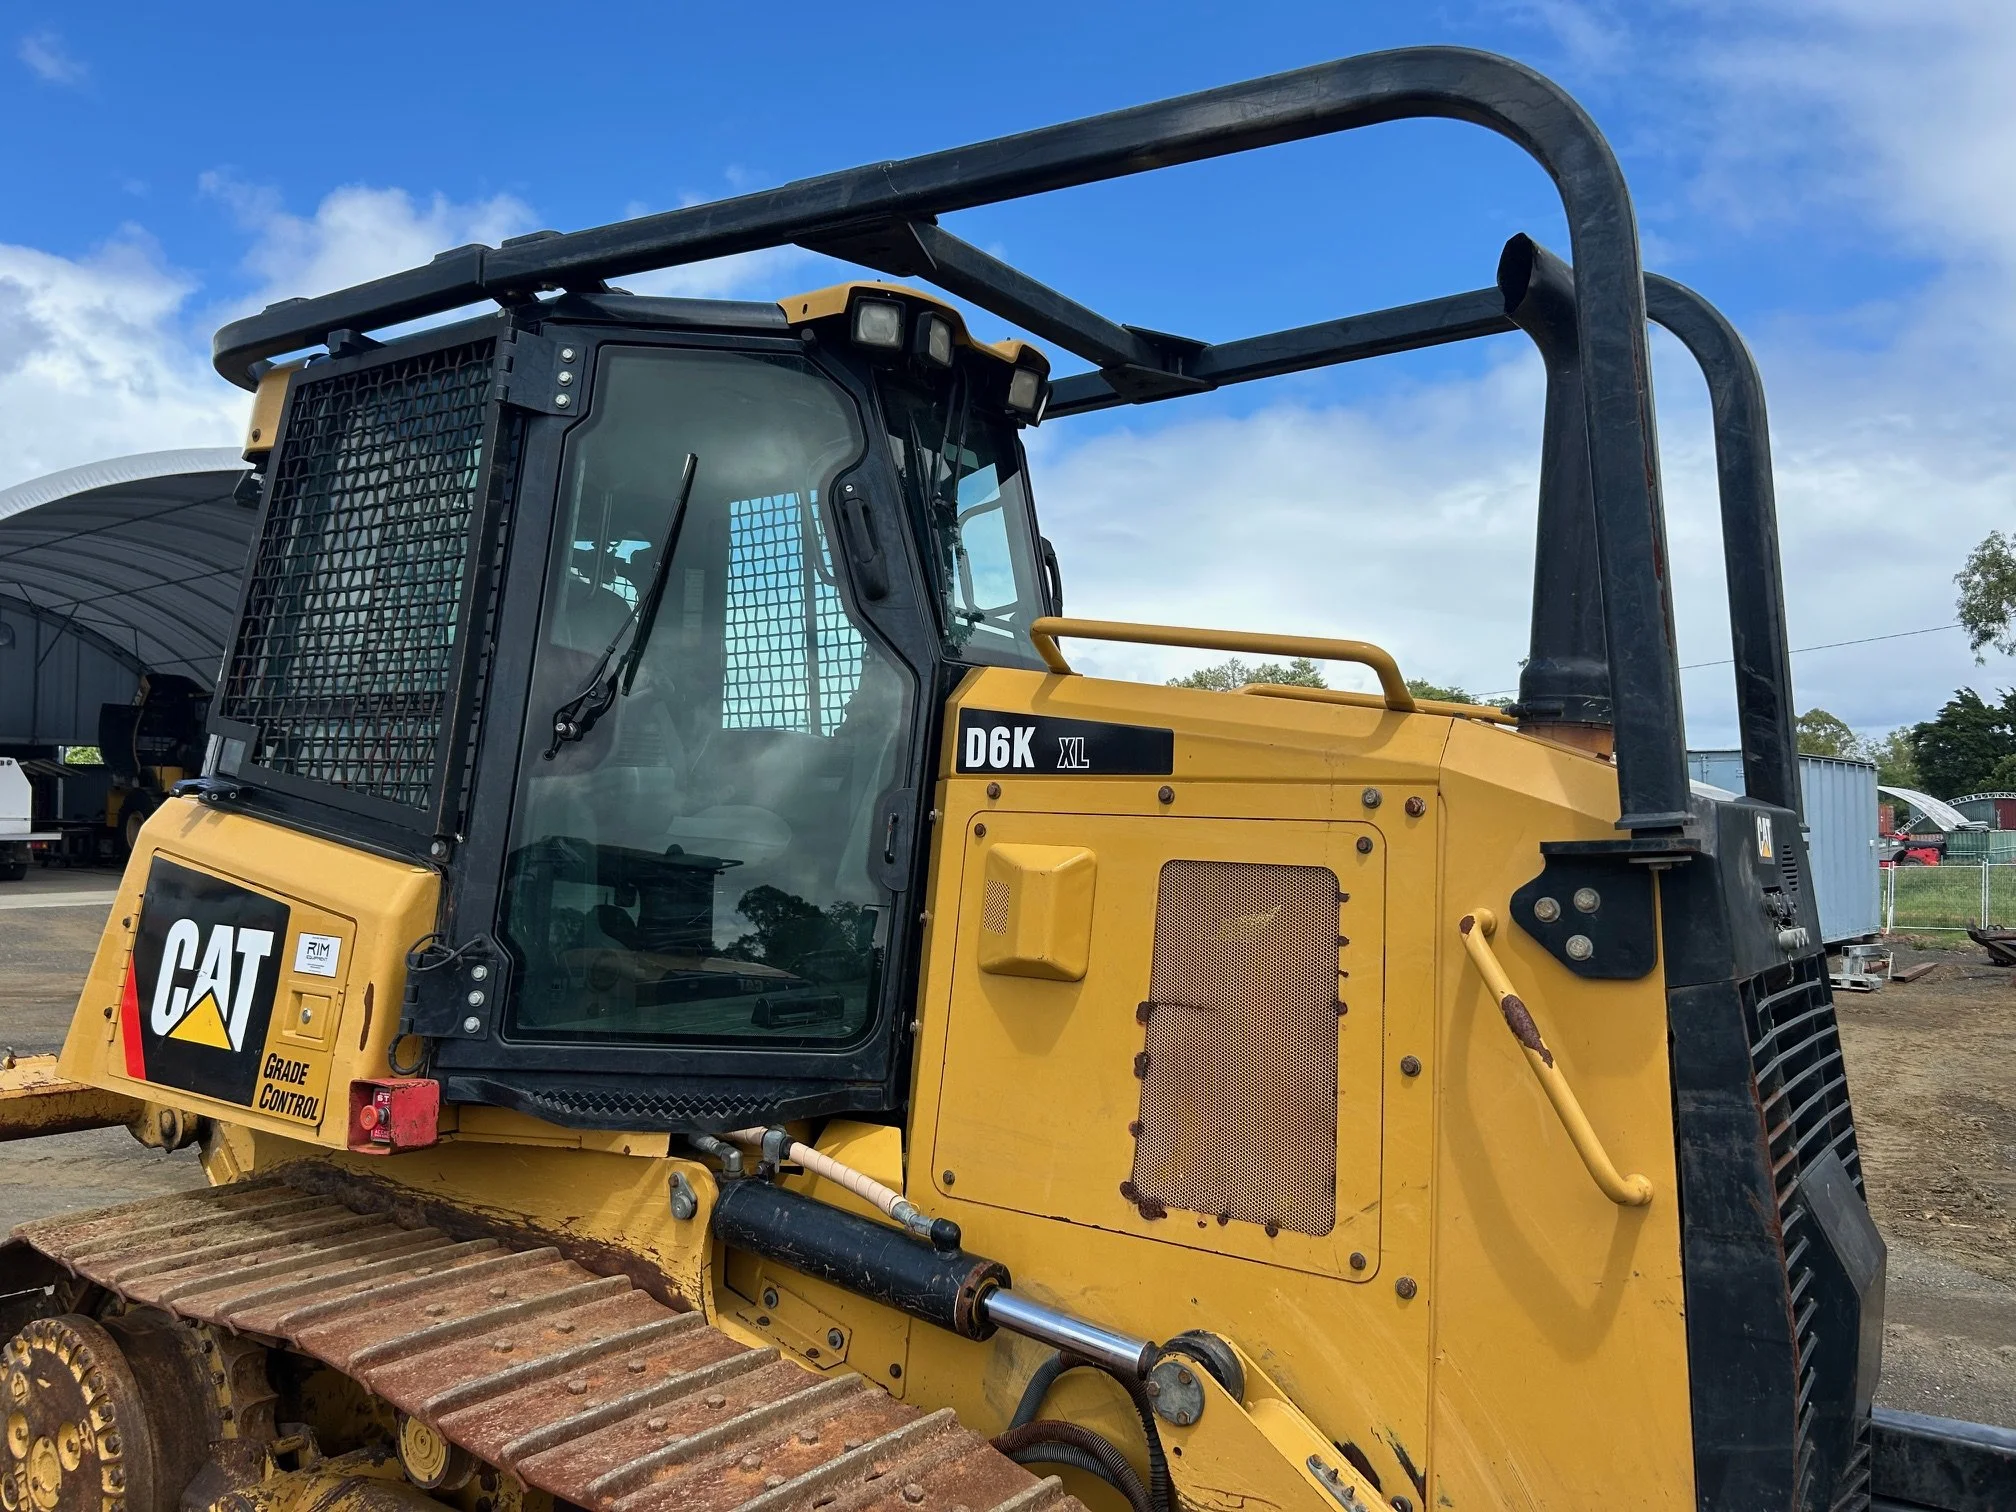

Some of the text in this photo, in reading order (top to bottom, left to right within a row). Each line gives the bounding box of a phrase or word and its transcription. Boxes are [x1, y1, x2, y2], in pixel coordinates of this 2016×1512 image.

[965, 725, 1090, 769] D6K XL
[1757, 815, 1773, 858] CAT
[306, 941, 331, 957] RIM
[151, 918, 275, 1053] CAT
[263, 1052, 311, 1086] GRADE
[258, 1082, 320, 1121] CONTROL
